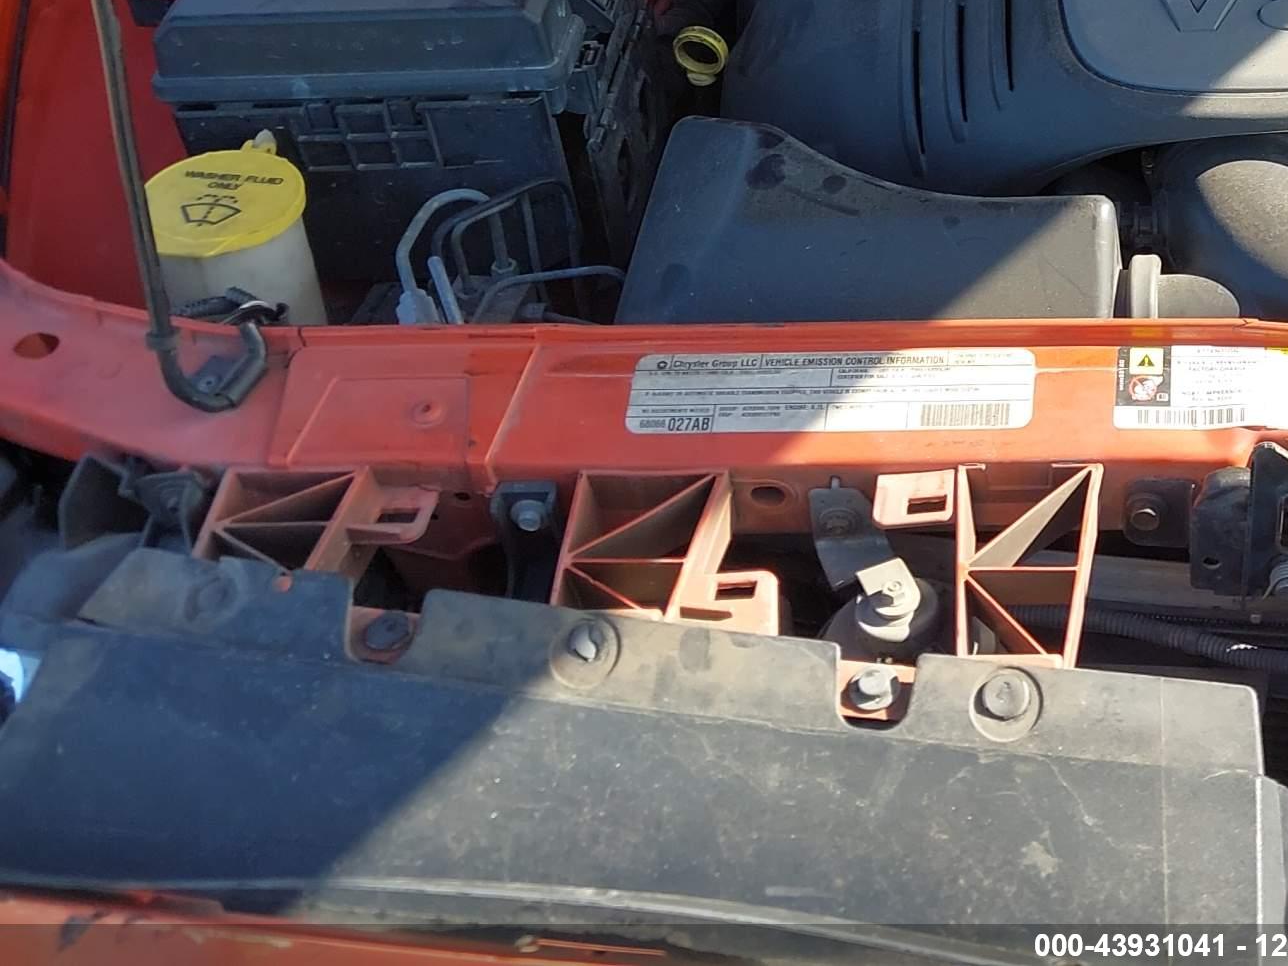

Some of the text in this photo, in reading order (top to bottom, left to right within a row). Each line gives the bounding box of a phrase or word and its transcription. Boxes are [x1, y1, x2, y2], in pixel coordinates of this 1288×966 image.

[184, 170, 285, 185] WASHER FLUID
[207, 181, 242, 190] ONLY
[673, 359, 709, 373] Chrysler
[711, 359, 738, 369] Group
[740, 358, 758, 368] LLC
[765, 357, 799, 367] VEHICLE
[802, 356, 842, 366] EMISSION
[845, 356, 883, 366] CONTROL
[886, 355, 944, 365] INFORMATION
[667, 417, 711, 432] 027AB
